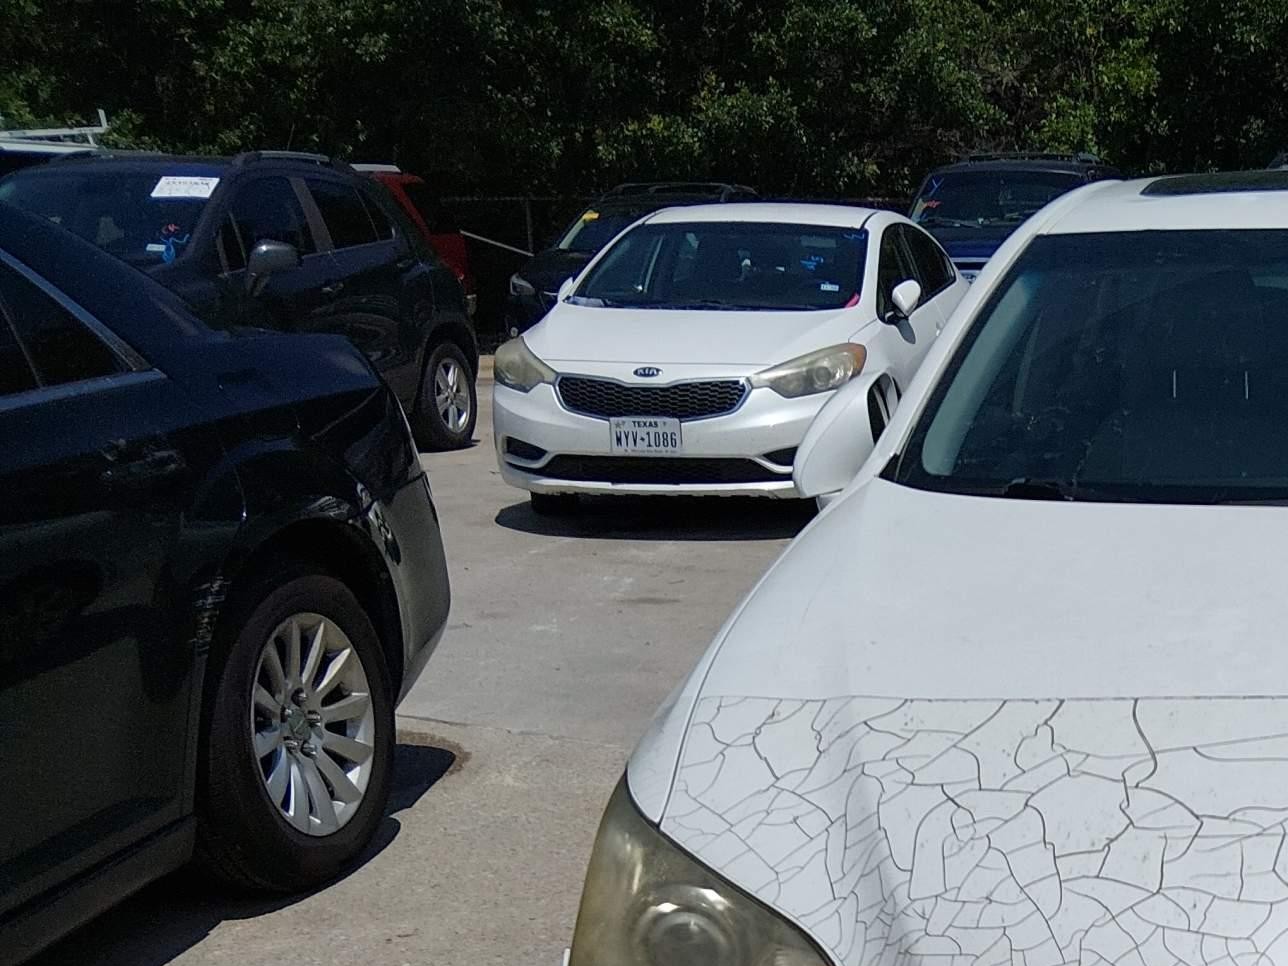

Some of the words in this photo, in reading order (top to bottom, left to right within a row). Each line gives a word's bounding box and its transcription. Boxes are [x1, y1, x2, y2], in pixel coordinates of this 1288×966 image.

[632, 420, 658, 428] TEXAS
[615, 430, 638, 447] WYV
[646, 431, 677, 448] 1086
